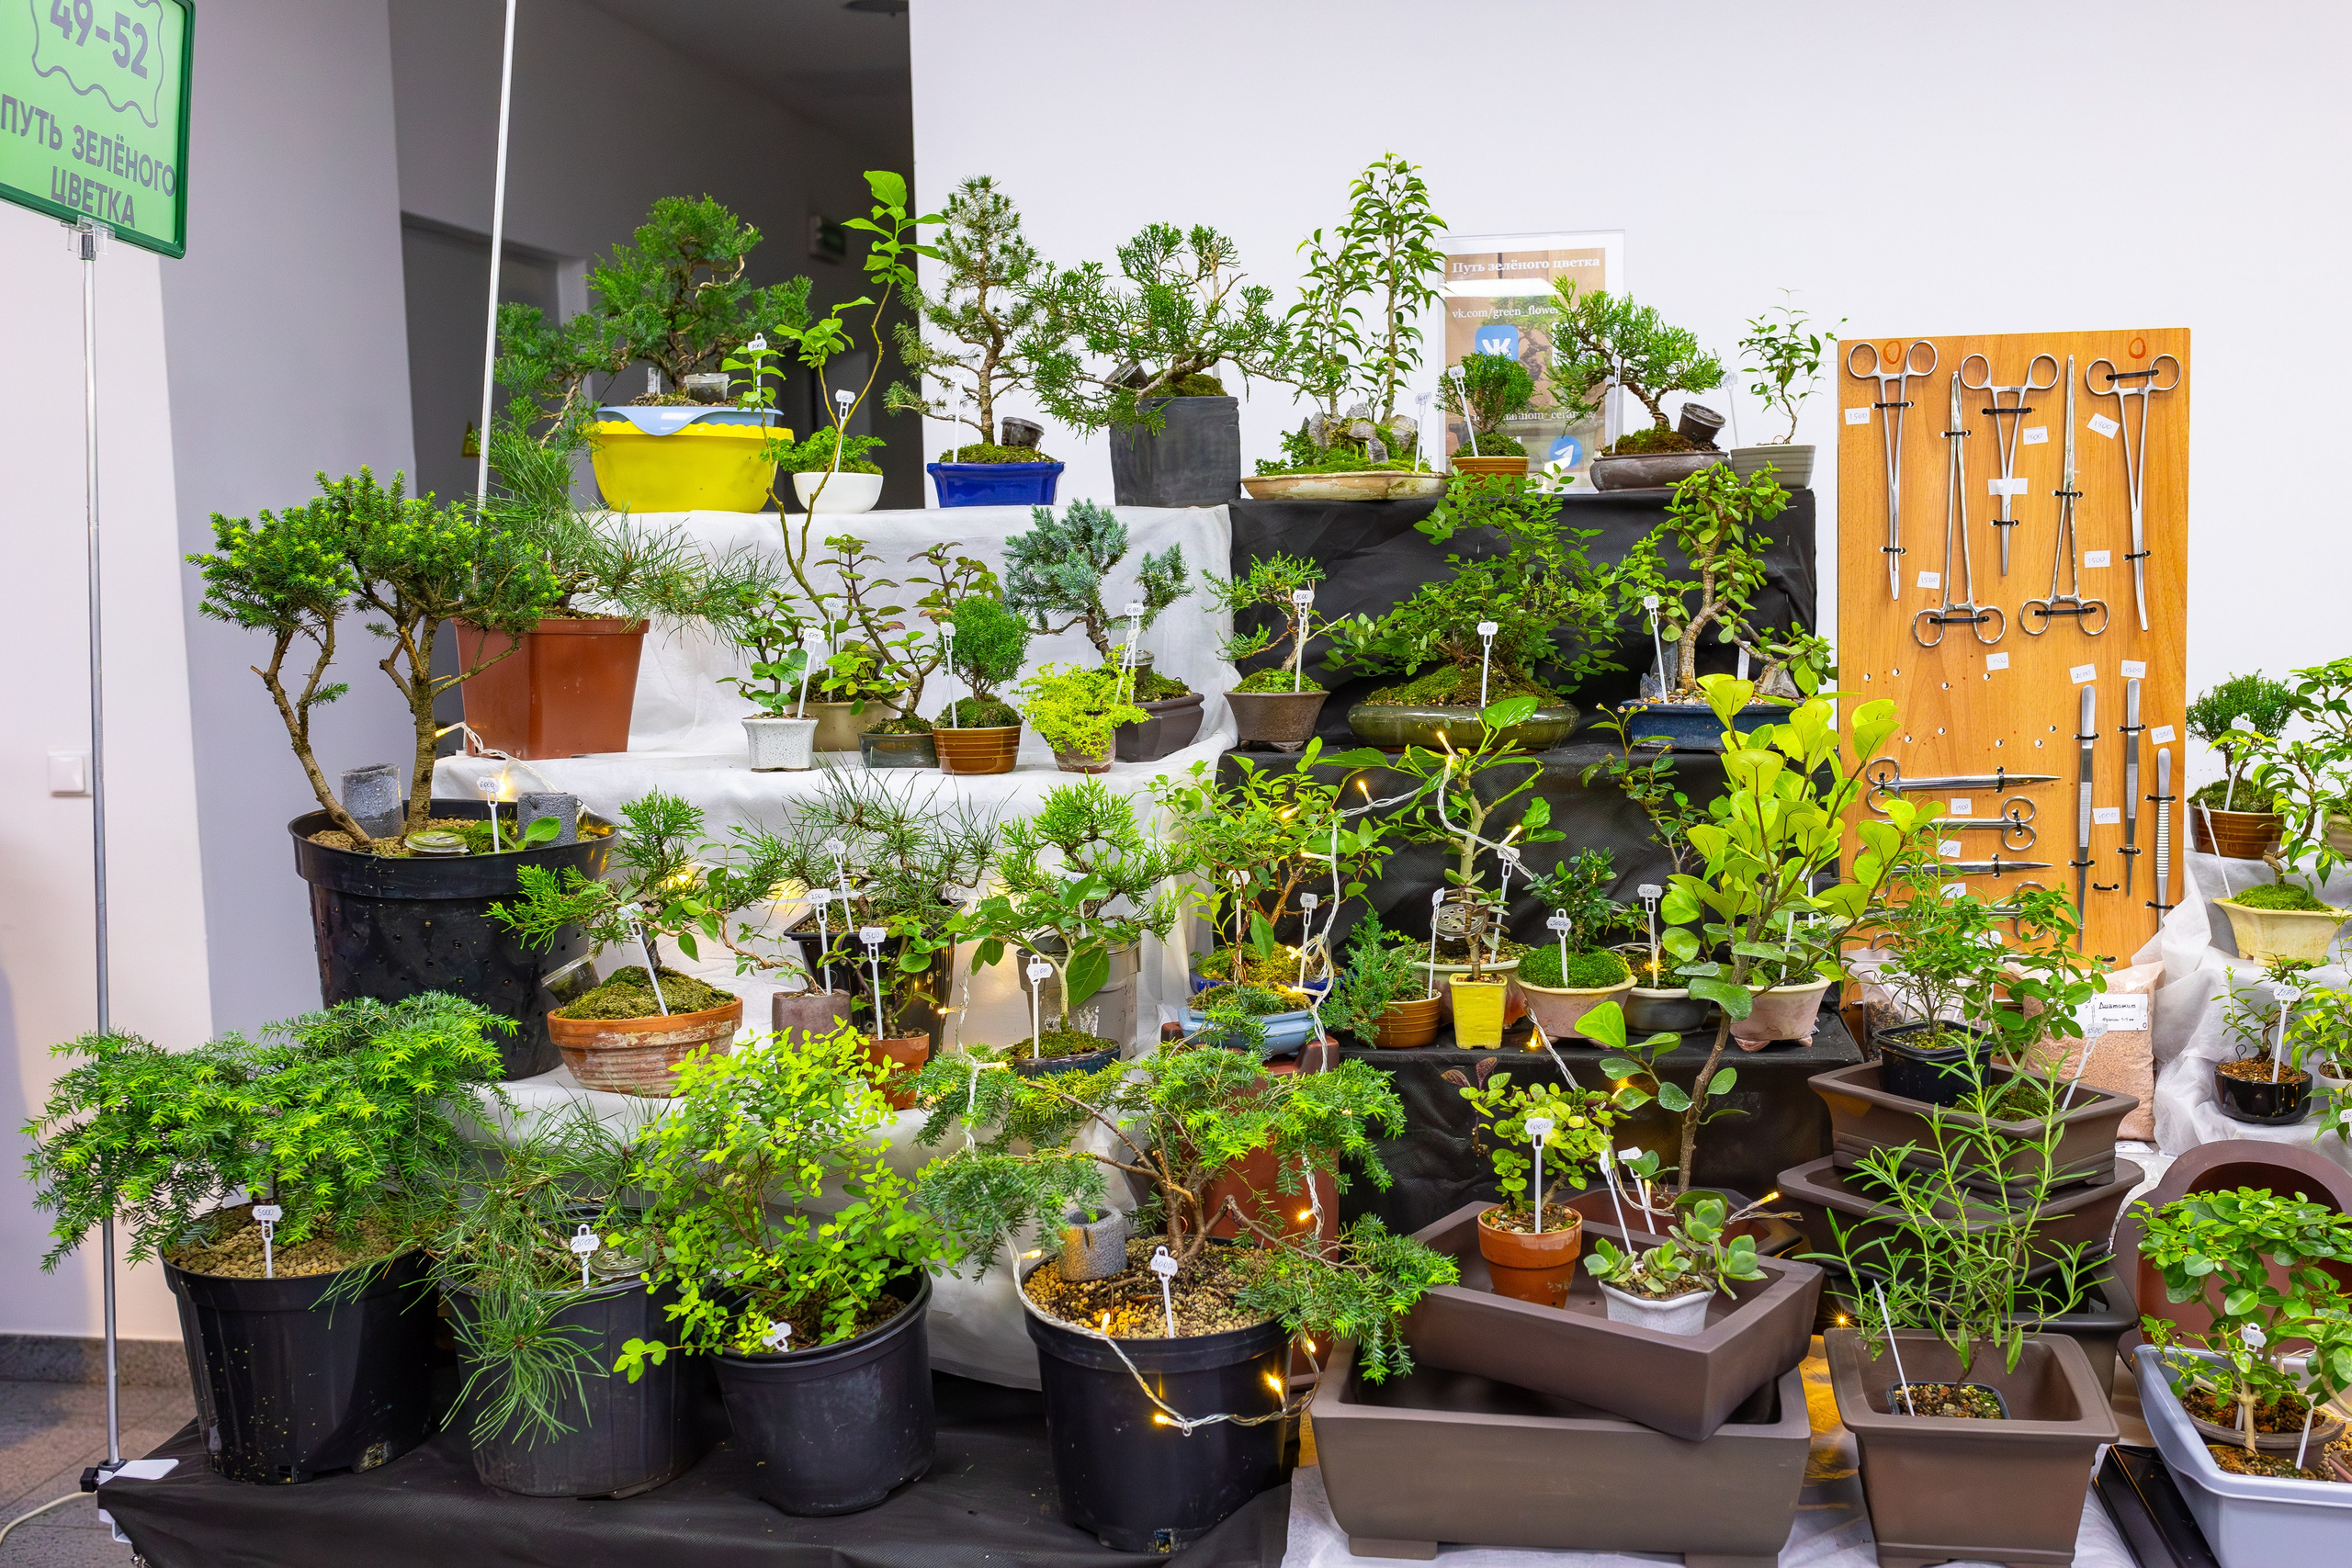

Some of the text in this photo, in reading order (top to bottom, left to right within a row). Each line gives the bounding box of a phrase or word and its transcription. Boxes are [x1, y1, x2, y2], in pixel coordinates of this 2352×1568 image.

[51, 0, 148, 80] 49-52
[1, 94, 175, 197] ПУТЬ ЗЕЛЁНОГО
[51, 165, 136, 229] ЦВЕТКА
[1452, 258, 1600, 275] Путь зелёного цветка
[2094, 421, 2112, 430] 1500
